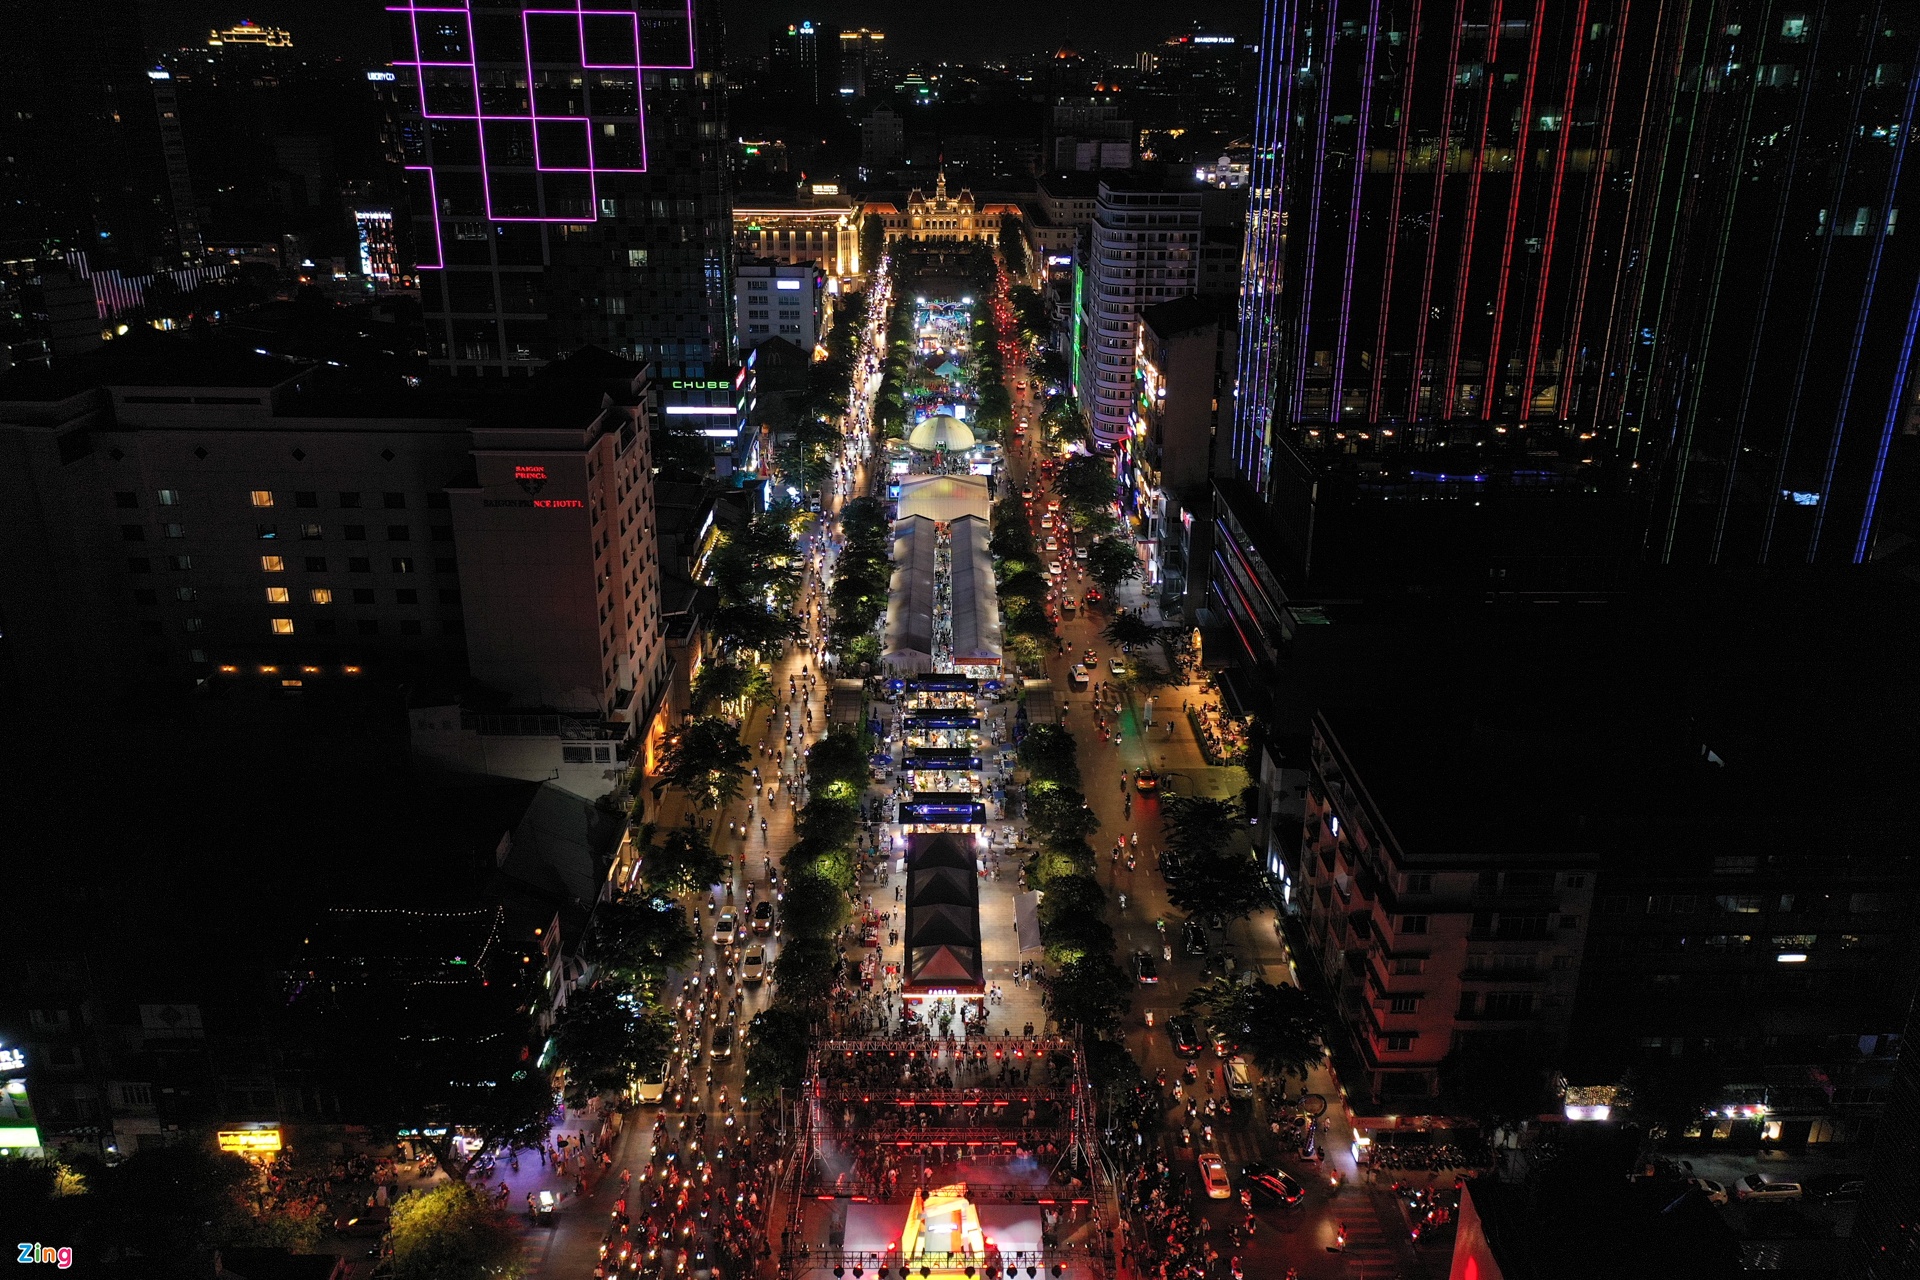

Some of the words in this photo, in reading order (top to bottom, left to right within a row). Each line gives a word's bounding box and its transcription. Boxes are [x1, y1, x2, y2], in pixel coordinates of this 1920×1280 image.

[672, 381, 729, 389] CHUBB
[515, 472, 548, 480] PRINCE
[483, 499, 517, 508] SAIGON
[518, 499, 552, 508] PRINCE
[553, 500, 584, 508] HOTEL
